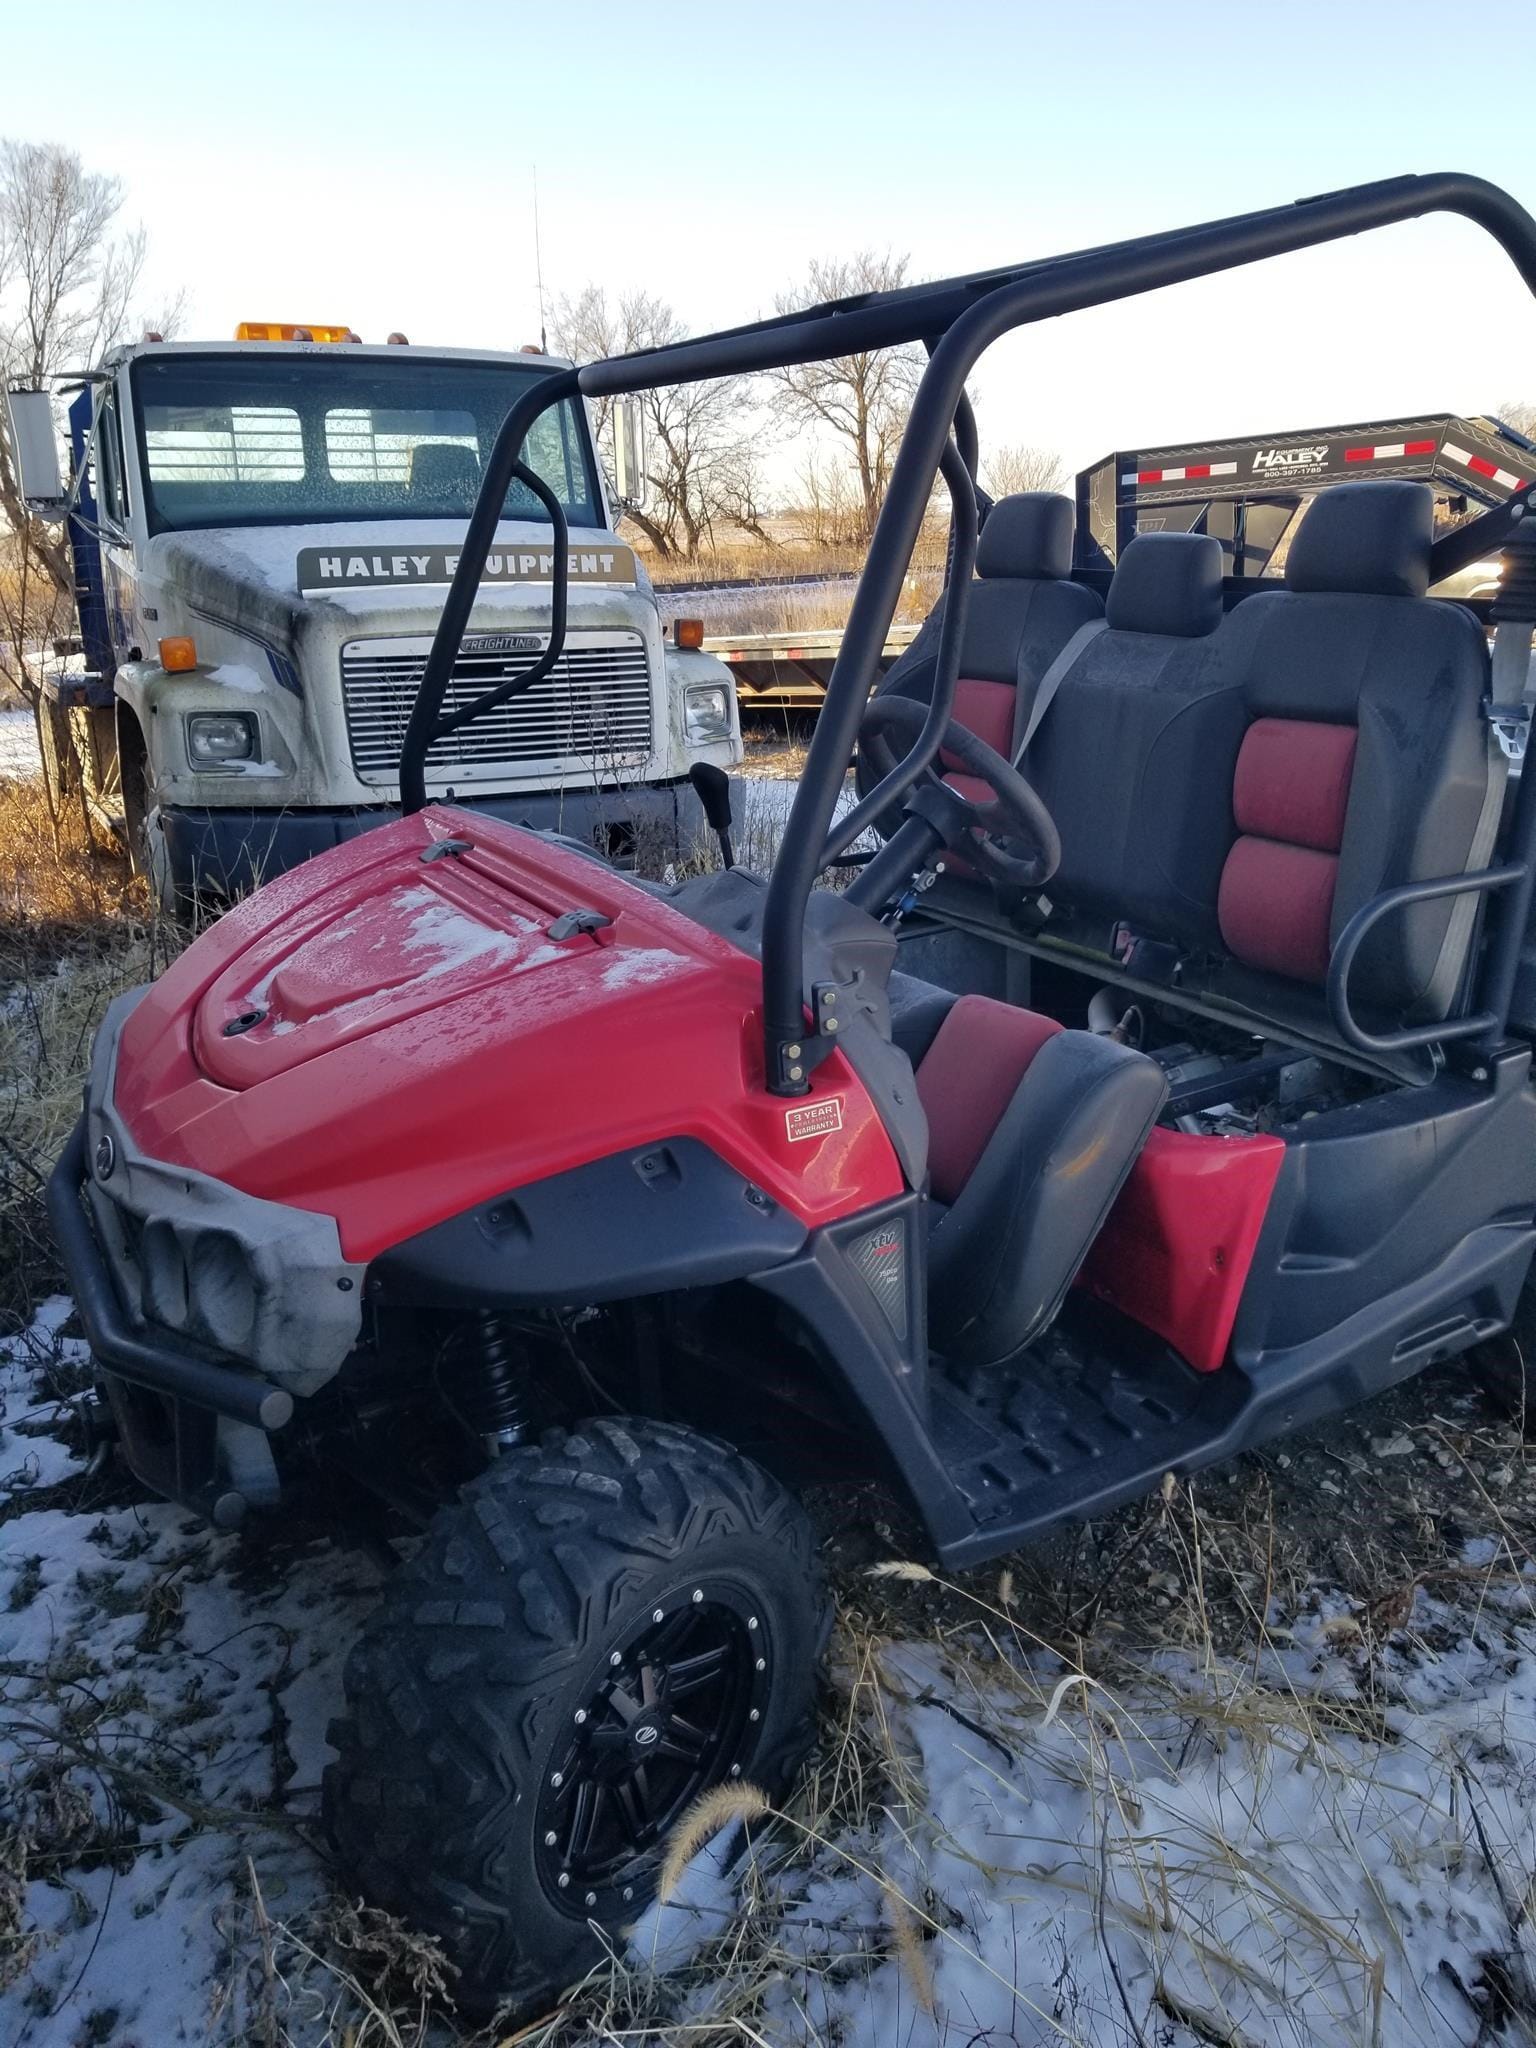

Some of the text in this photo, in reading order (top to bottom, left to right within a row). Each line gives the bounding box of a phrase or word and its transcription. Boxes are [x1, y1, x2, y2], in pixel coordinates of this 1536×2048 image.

[1252, 448, 1329, 469] HALEY
[319, 553, 614, 577] HALEY EUIPMENT
[464, 636, 539, 650] FREIGHTLINER
[793, 1112, 802, 1122] 3
[804, 1106, 833, 1120] YEAR
[795, 1119, 834, 1136] WARRANTY
